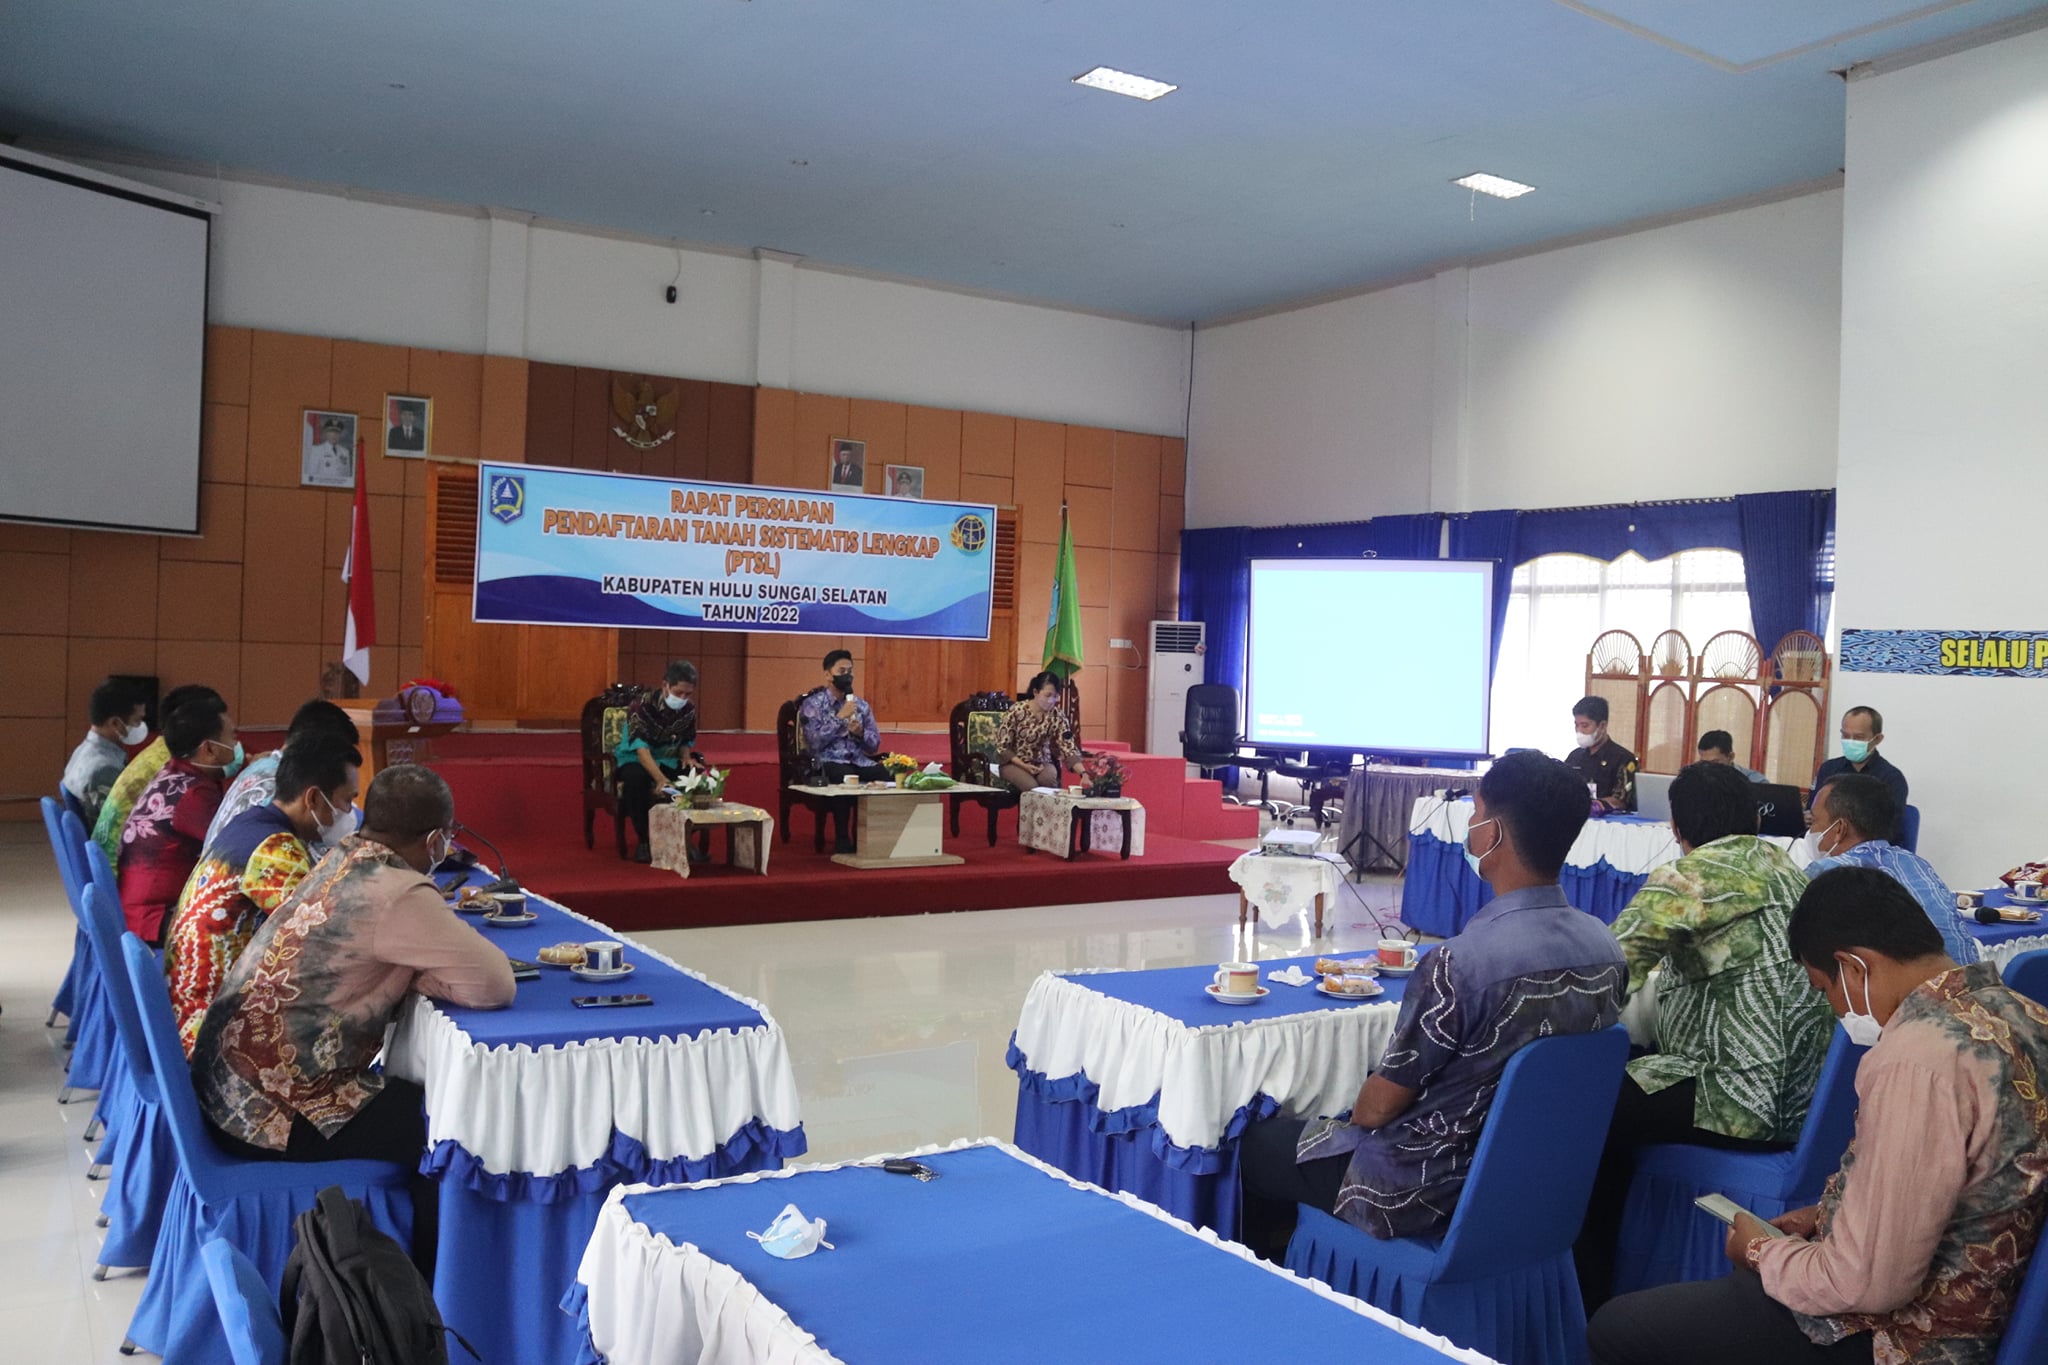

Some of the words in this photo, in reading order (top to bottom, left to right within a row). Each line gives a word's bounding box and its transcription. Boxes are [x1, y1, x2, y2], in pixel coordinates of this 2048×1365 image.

[671, 490, 731, 516] RAPAT
[735, 497, 834, 524] PERSIAPAN
[543, 509, 687, 541] PENDAFTARAN
[692, 521, 756, 546] TANAH
[759, 525, 859, 553] SISTEMATIS
[862, 532, 940, 558] LENGKAP
[725, 549, 781, 578] (PTSL)
[603, 576, 703, 595] KABUPATEN
[709, 582, 753, 598] HULU
[758, 585, 816, 602] SUNGAI
[821, 589, 887, 604] SELATAN
[702, 604, 757, 622] TAHUN
[761, 606, 798, 623] 2022
[1941, 639, 2028, 669] SELALU
